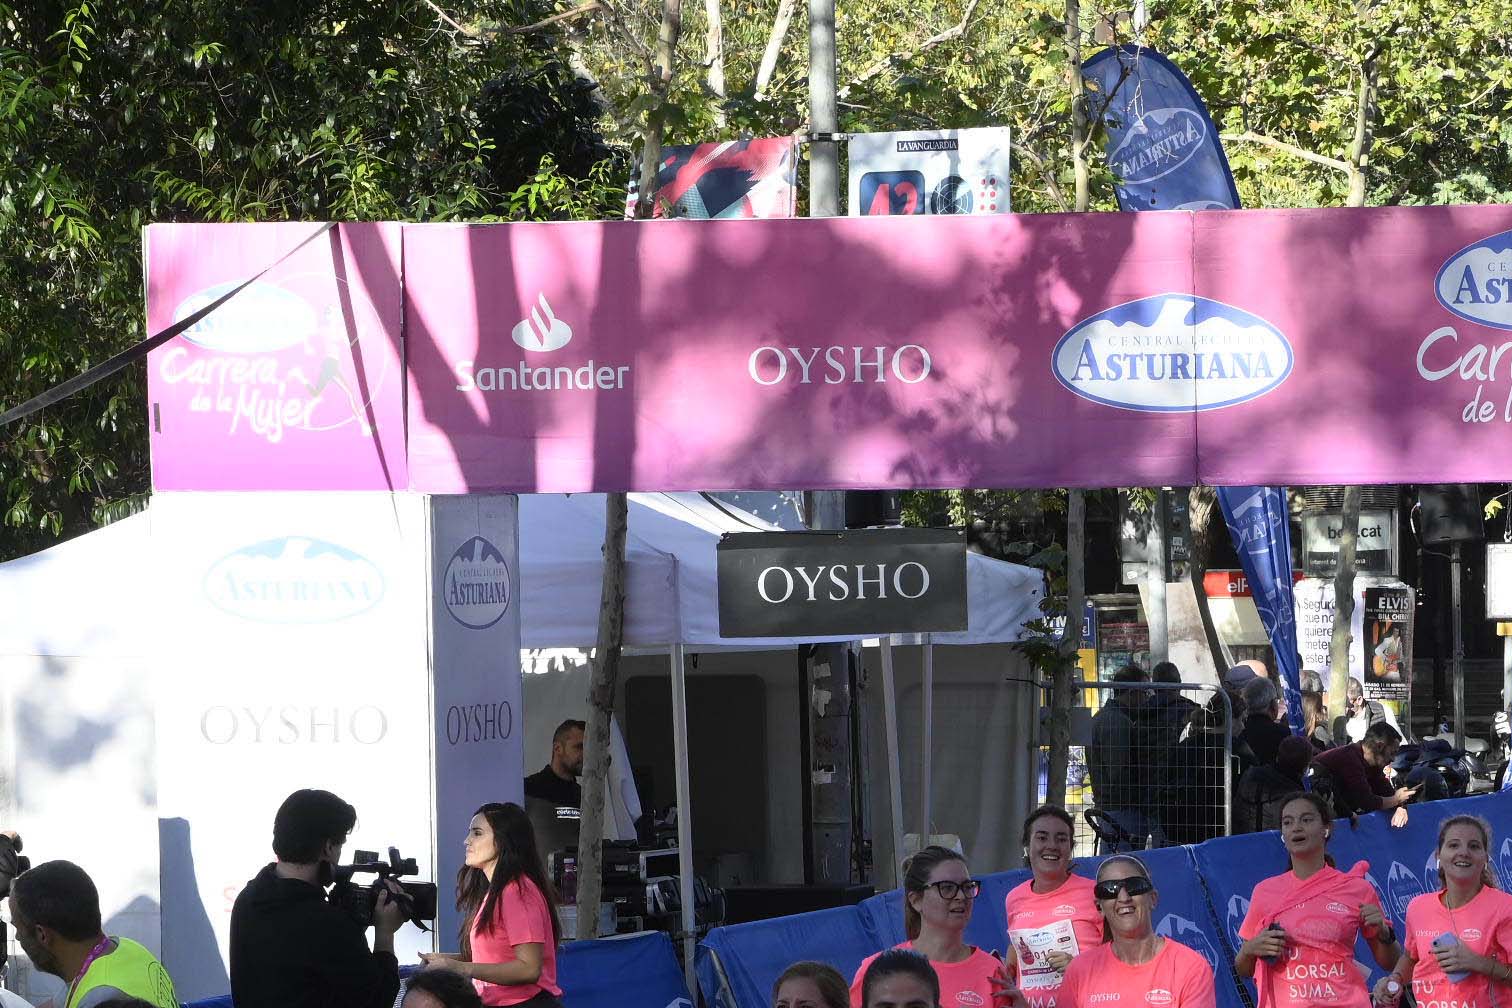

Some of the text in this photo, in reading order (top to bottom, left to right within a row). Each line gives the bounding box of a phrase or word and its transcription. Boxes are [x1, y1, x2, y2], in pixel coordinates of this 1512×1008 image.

[1108, 335, 1188, 347] CENTRAL
[456, 360, 629, 392] Santander
[748, 344, 931, 386] OYSHO
[1071, 337, 1275, 382] ASTURIANA
[1462, 388, 1497, 423] de
[449, 571, 507, 606] ASTURIANA
[758, 562, 930, 604] OYSHO
[1378, 597, 1409, 609] ELVIS
[200, 704, 388, 746] OYSHO
[446, 700, 513, 746] OYSHO
[1090, 993, 1121, 1004] OYSHO
[1289, 983, 1336, 998] SUMA
[1413, 980, 1434, 994] TU
